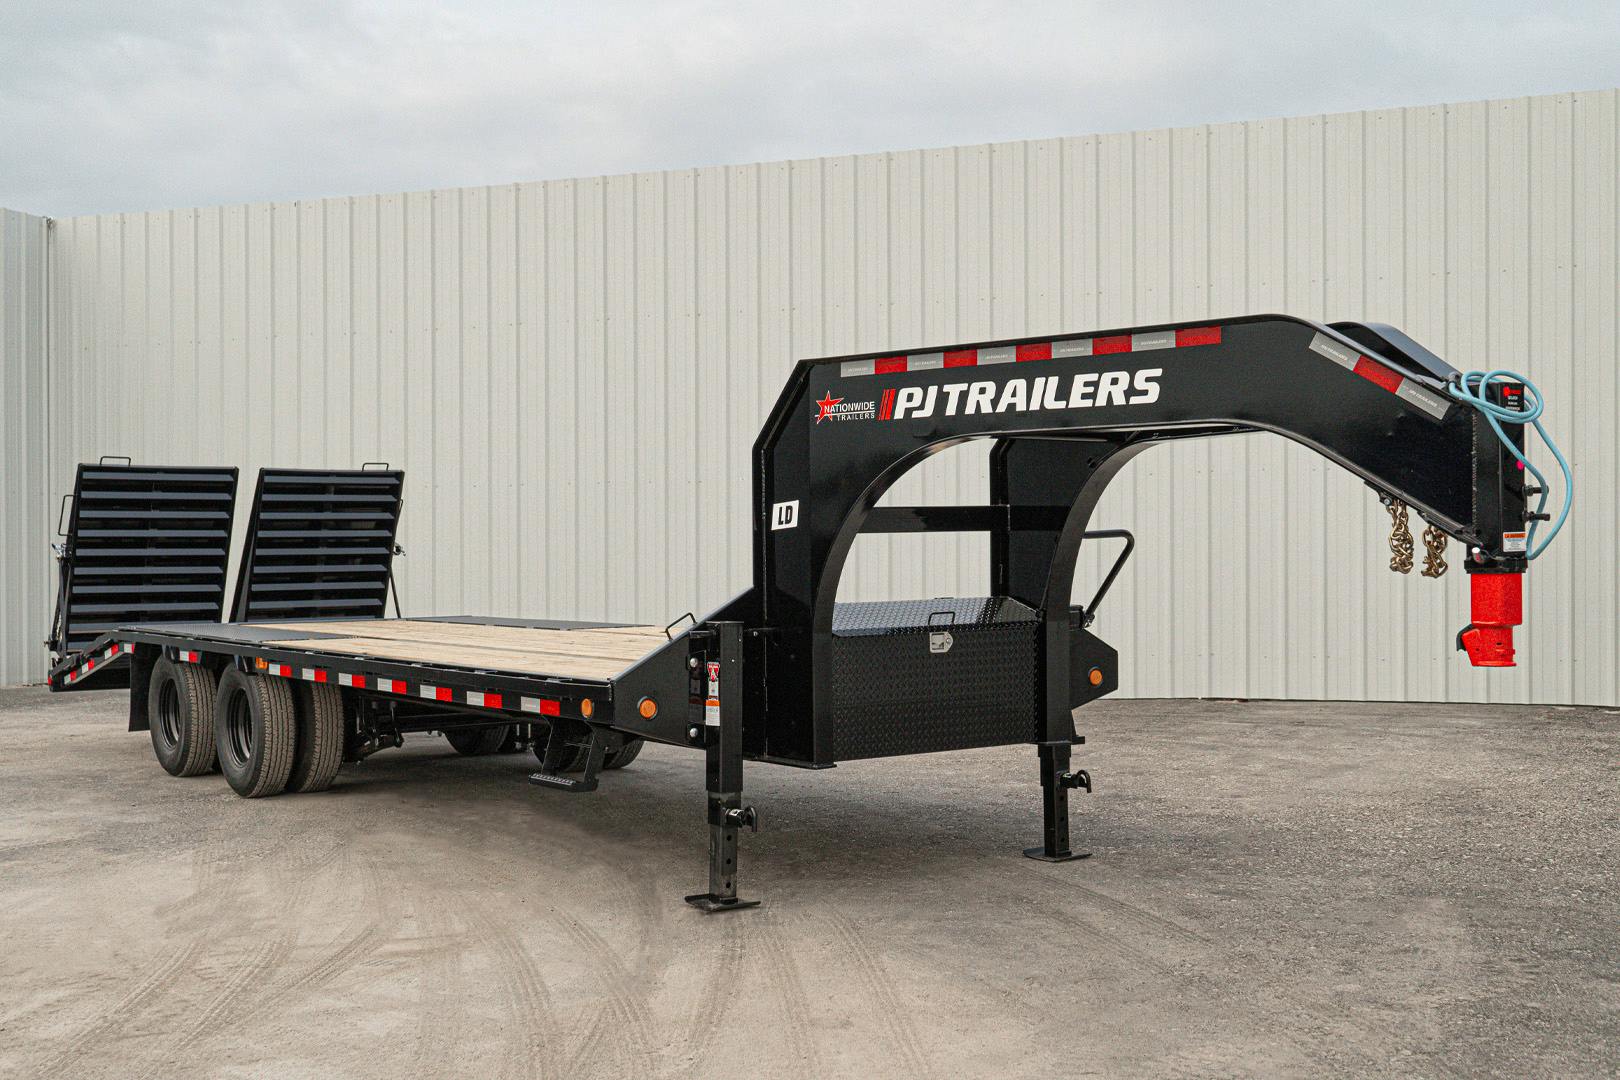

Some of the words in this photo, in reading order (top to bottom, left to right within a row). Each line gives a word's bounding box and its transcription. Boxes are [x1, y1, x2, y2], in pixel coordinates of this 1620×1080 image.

[942, 368, 1163, 416] TRAILERS
[824, 401, 875, 413] NATIONWIDE
[837, 412, 875, 421] TRAILERS
[778, 505, 793, 526] LD
